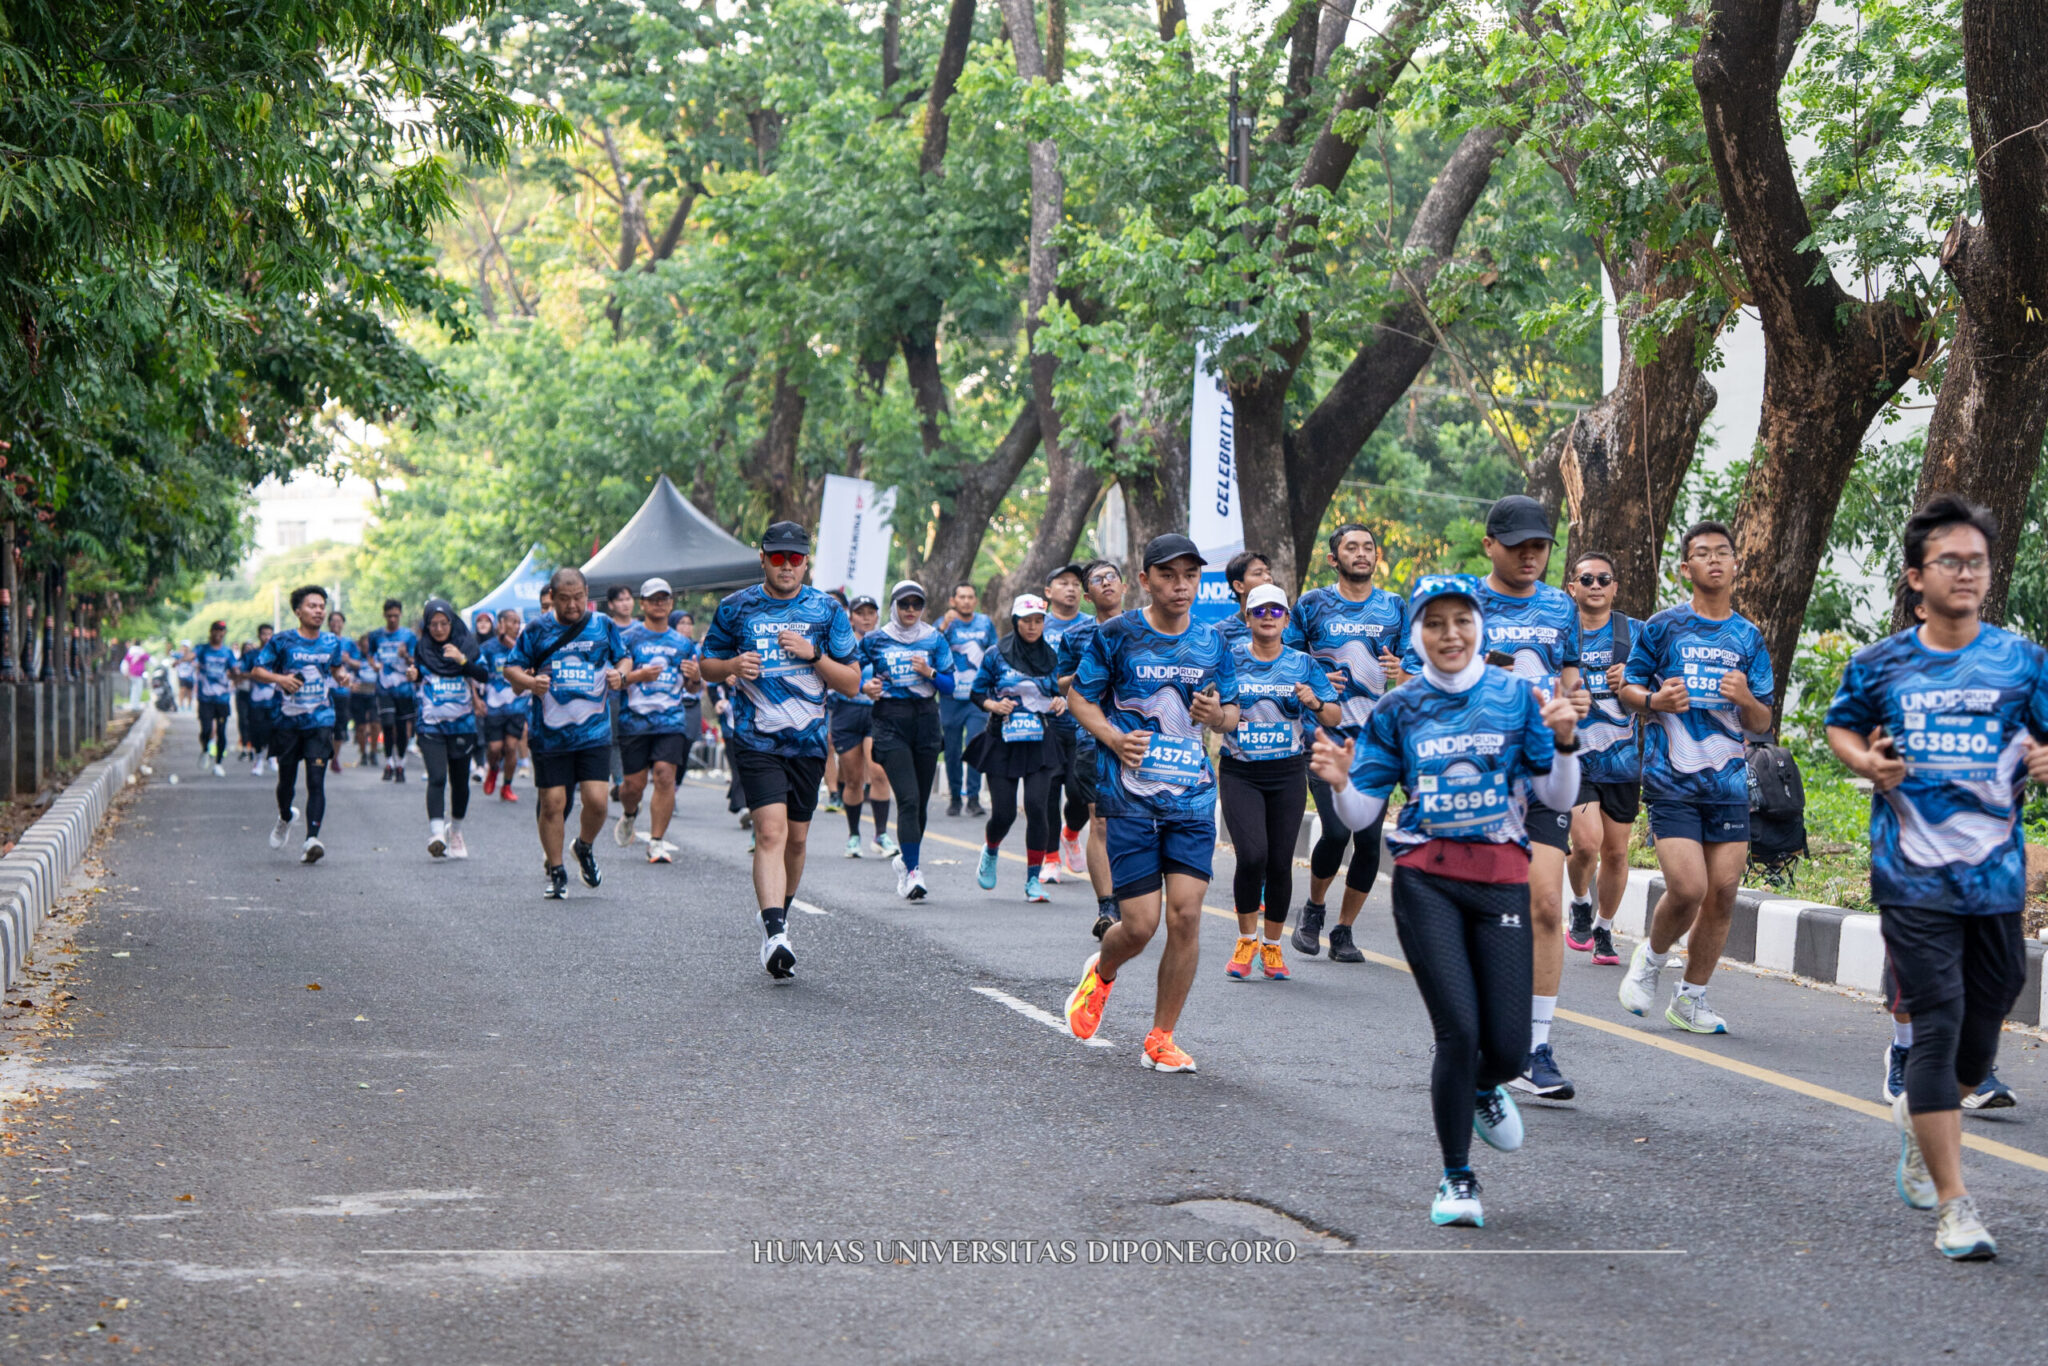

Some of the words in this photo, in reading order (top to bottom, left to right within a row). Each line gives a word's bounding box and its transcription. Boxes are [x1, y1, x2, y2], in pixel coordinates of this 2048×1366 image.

[1216, 405, 1233, 517] CELEBRITY
[754, 623, 790, 634] UNDIP
[1330, 623, 1365, 633] UNDIP
[1488, 627, 1535, 641] UNDIP
[1581, 651, 1600, 661] DIP
[1681, 646, 1721, 660] UNDIP
[1722, 650, 1739, 661] RUN
[556, 669, 587, 680] J3512
[1136, 665, 1180, 679] UNDIP
[1180, 667, 1200, 677] RUN
[1181, 677, 1199, 685] 2024
[1239, 683, 1275, 694] UNDIP
[1901, 689, 1963, 711] UNDIP
[1964, 690, 1997, 702] RUN
[1239, 732, 1285, 744] M3678
[1908, 731, 1988, 754] G3830
[1417, 734, 1473, 758] UNDIP
[1474, 734, 1502, 746] RUN
[1475, 746, 1500, 755] 2024
[1423, 788, 1498, 813] K3696
